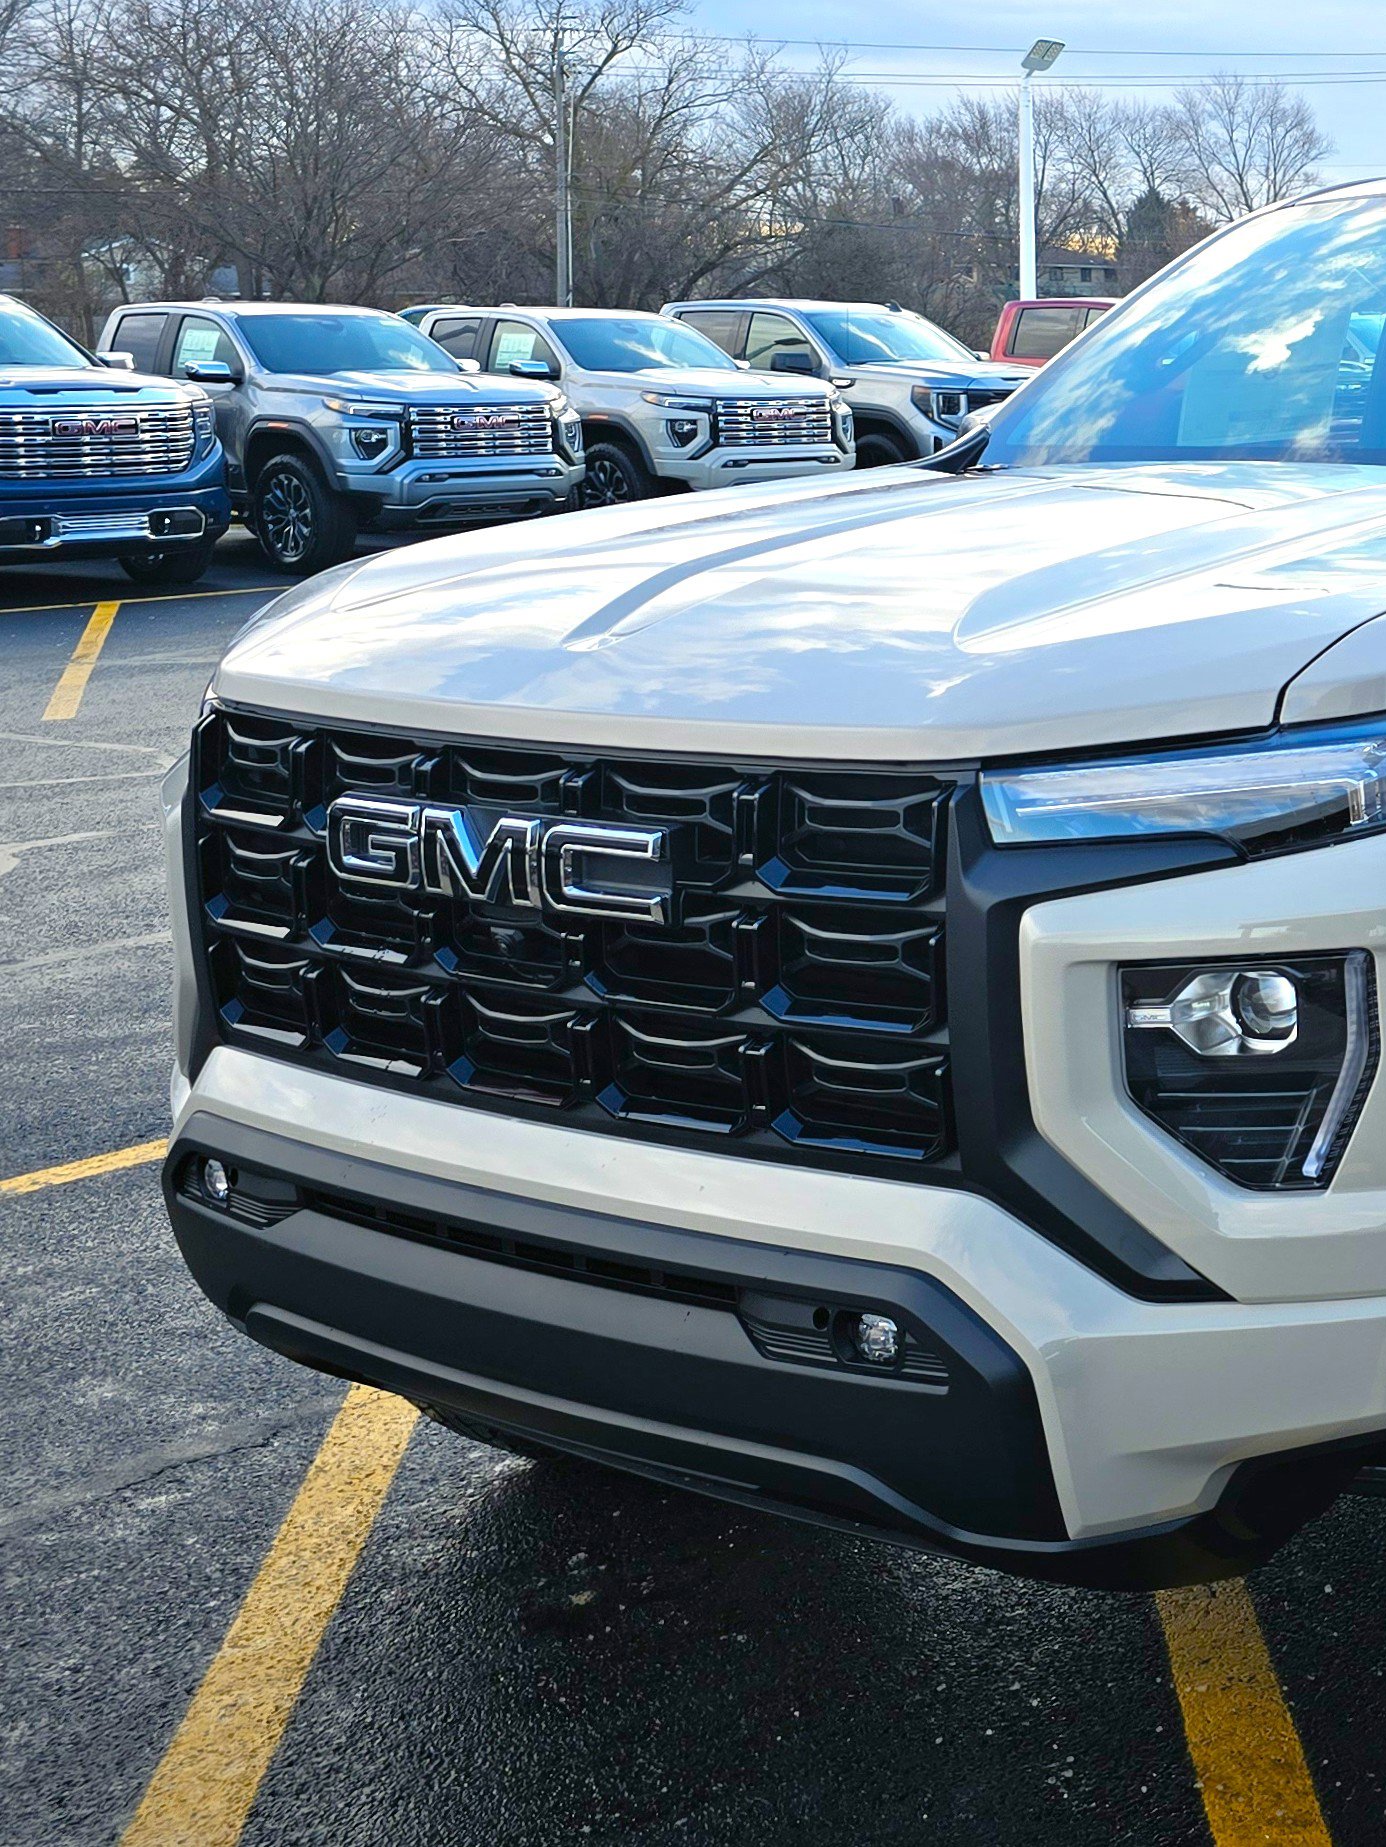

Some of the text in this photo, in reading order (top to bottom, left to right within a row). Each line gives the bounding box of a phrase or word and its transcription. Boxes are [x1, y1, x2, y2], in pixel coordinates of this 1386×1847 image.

[54, 419, 136, 435] GMC
[453, 415, 519, 430] GMC
[326, 796, 665, 926] GMC
